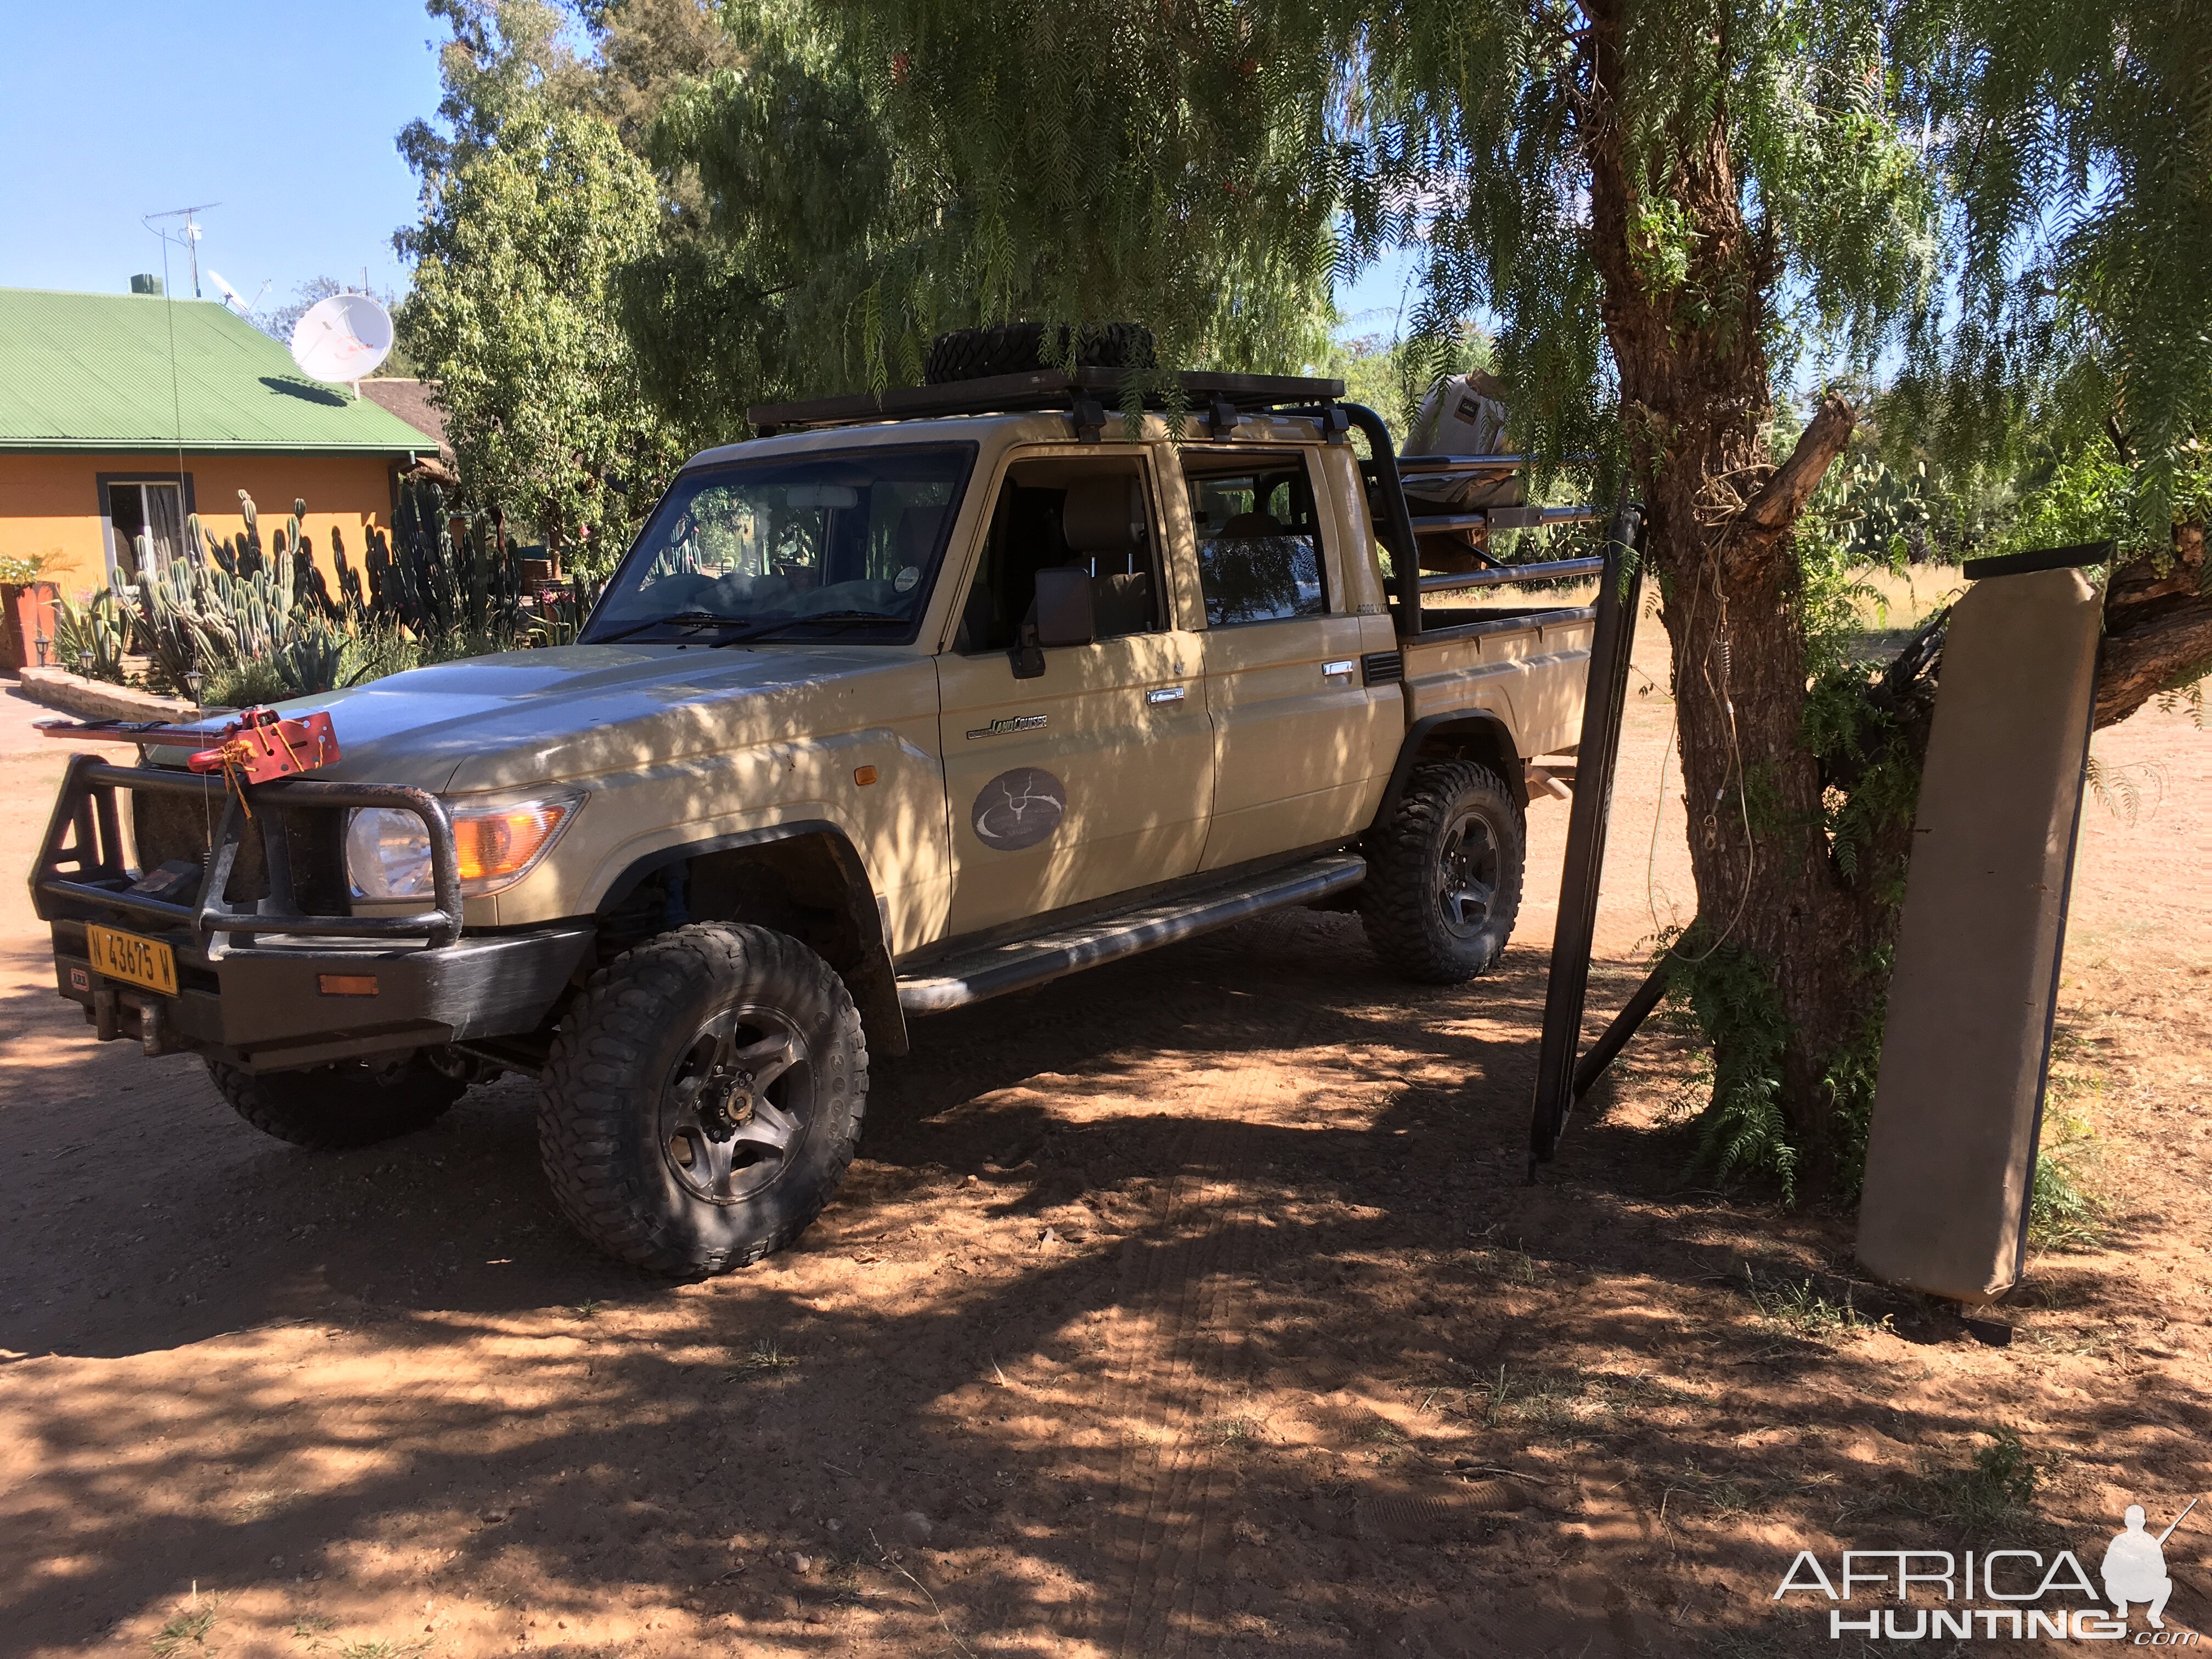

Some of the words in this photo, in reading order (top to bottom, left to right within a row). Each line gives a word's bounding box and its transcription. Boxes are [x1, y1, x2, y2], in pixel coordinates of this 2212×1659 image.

[1357, 604, 1374, 613] 4000
[92, 930, 103, 967] N
[109, 934, 154, 981] 43675
